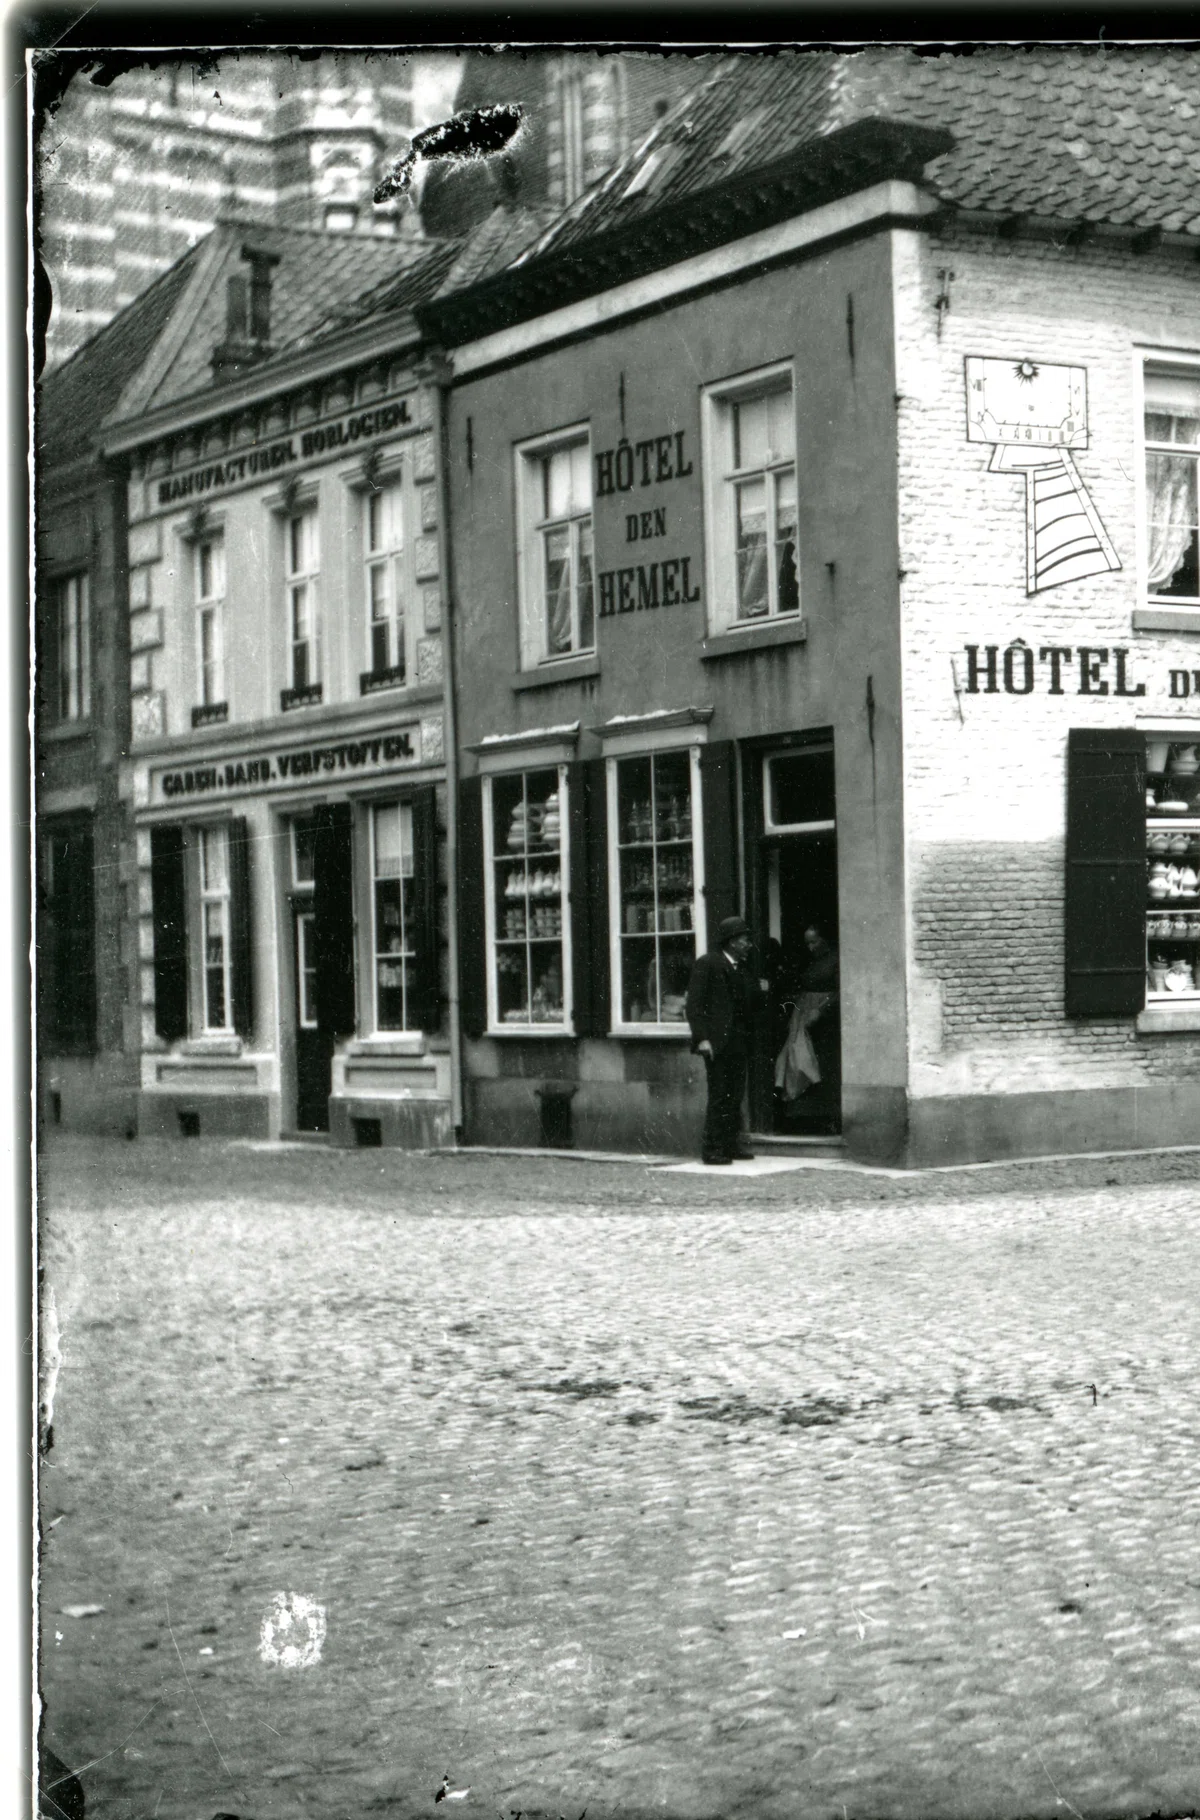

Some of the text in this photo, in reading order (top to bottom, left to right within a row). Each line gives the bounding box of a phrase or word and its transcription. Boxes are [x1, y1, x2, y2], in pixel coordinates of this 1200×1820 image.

[594, 430, 693, 497] HÔTEL
[625, 507, 667, 543] DEN
[597, 556, 700, 619] HEMEL
[963, 638, 1146, 697] HÔTEL
